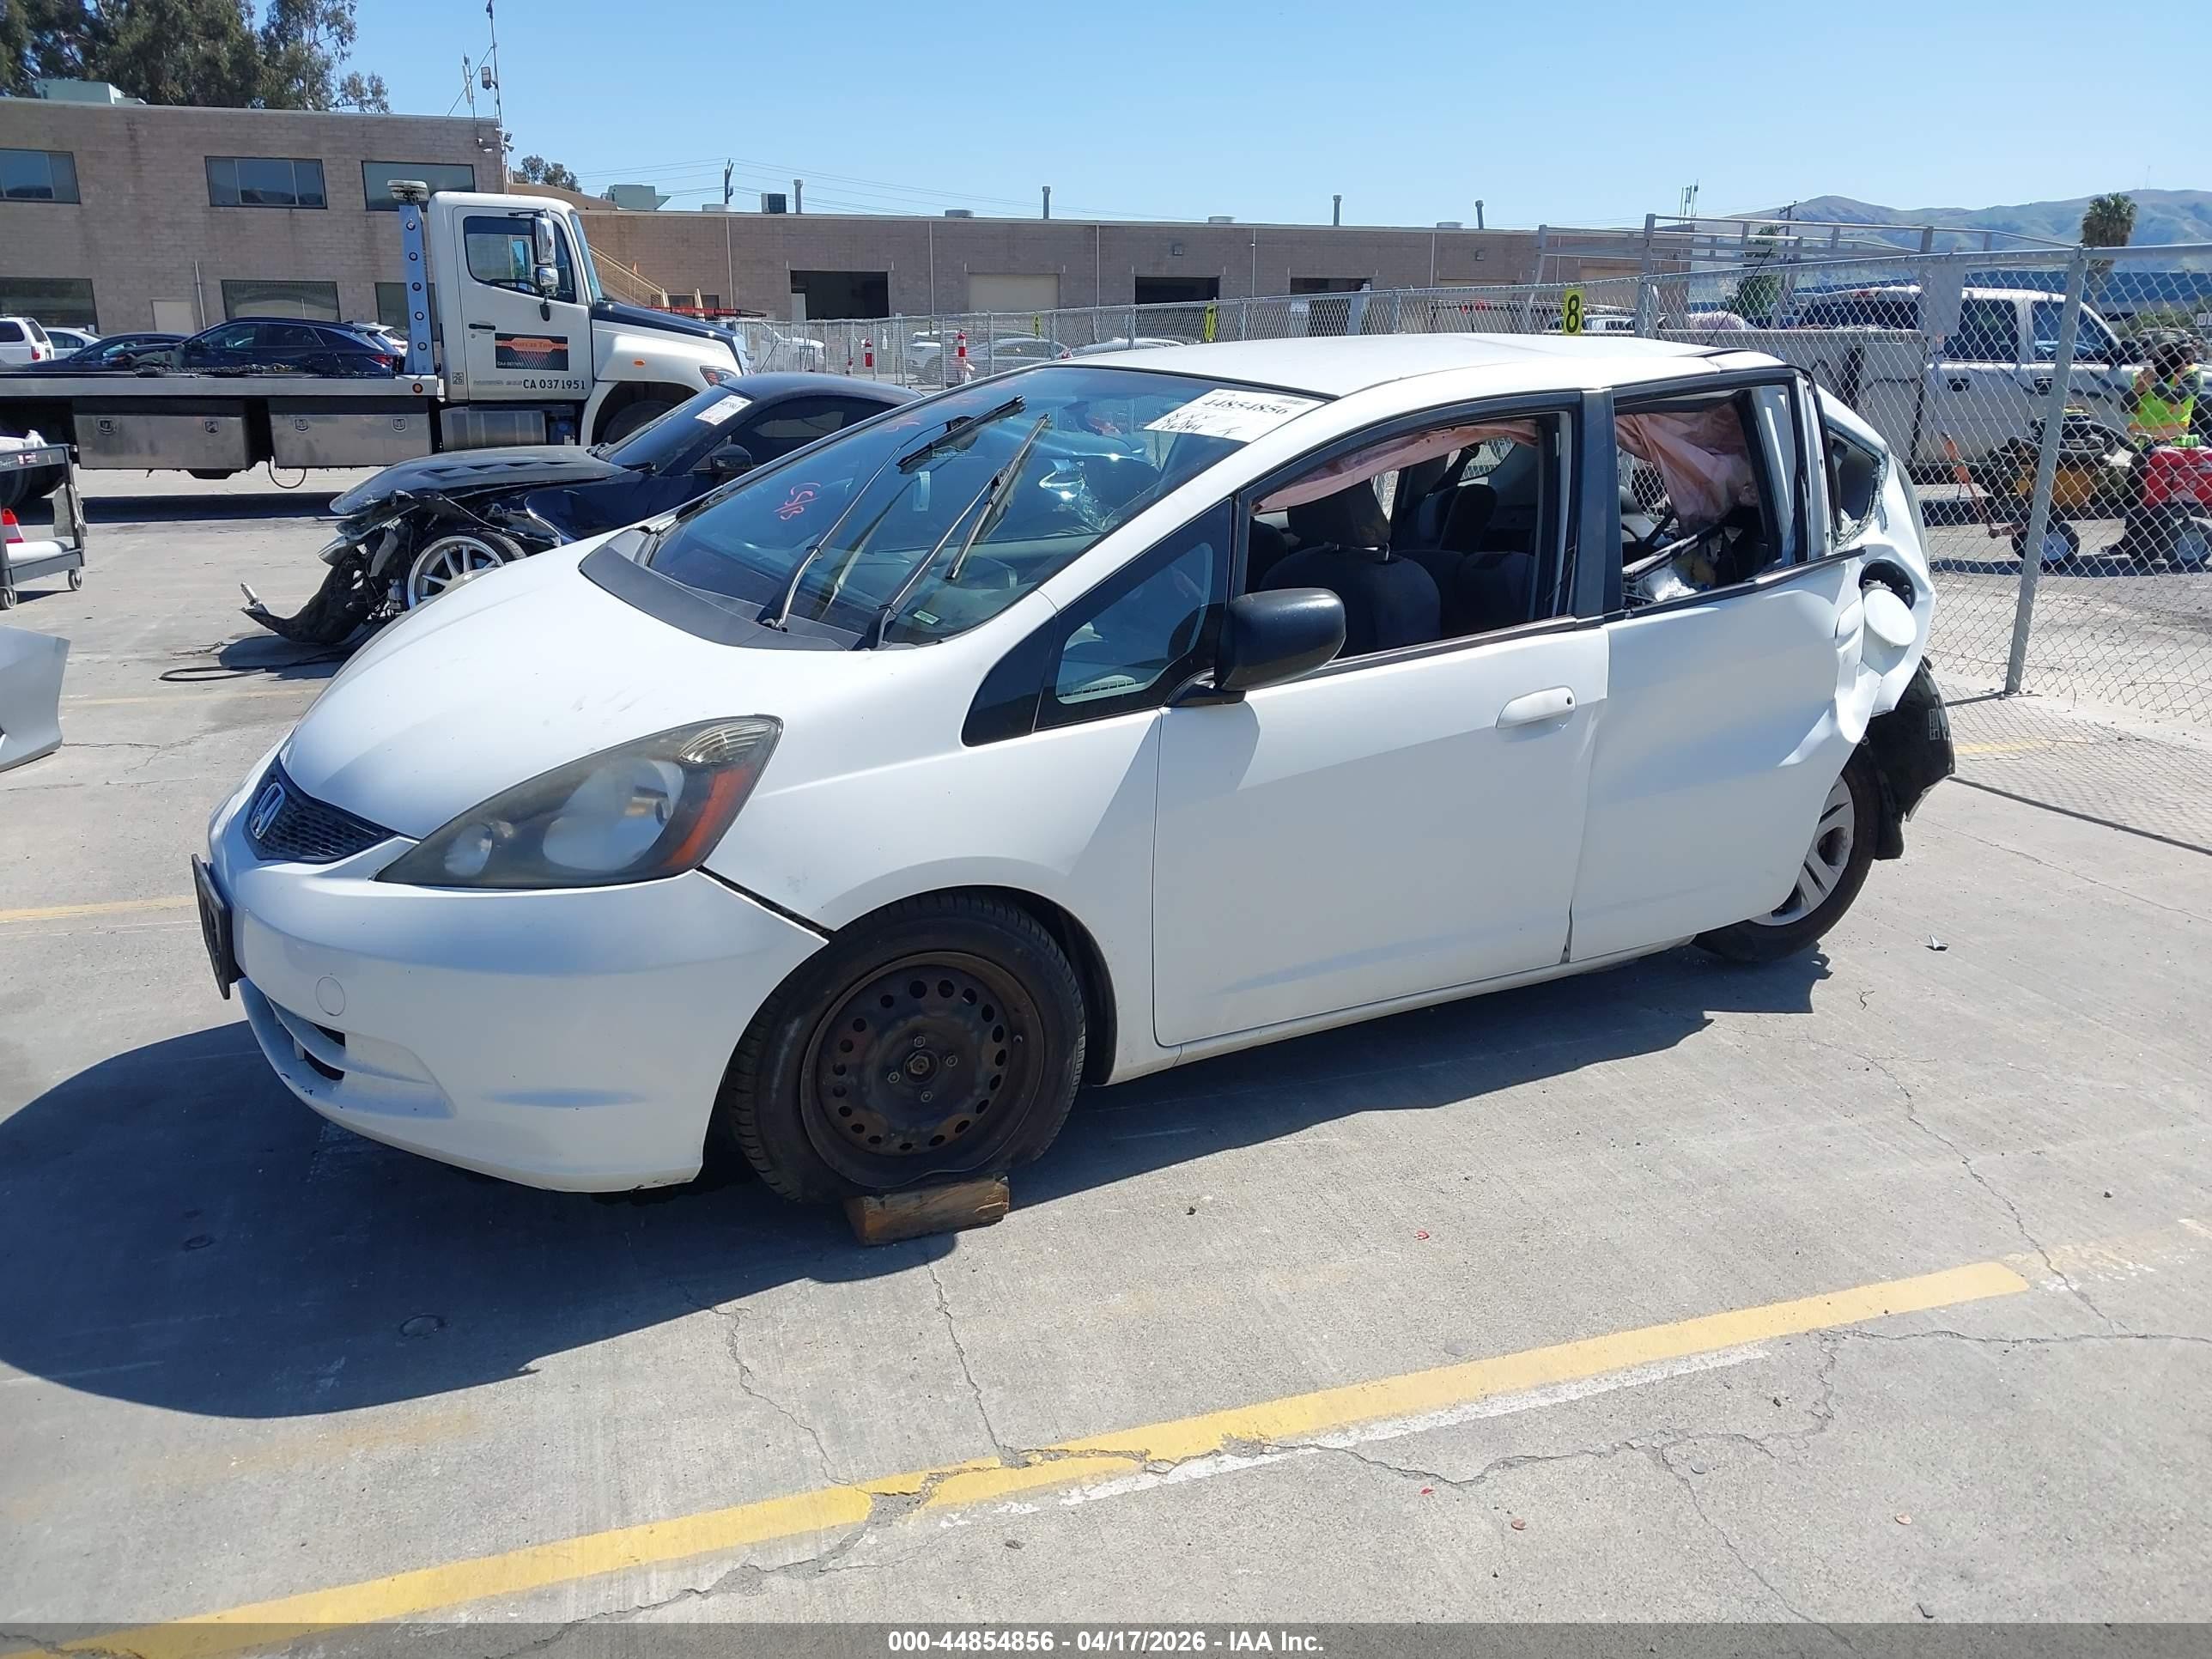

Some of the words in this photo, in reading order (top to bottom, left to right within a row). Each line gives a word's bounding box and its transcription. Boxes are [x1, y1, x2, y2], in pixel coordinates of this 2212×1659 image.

[1566, 295, 1580, 333] 8
[522, 379, 537, 390] CA
[539, 380, 586, 390] 0371951
[1202, 398, 1290, 415] 44854856
